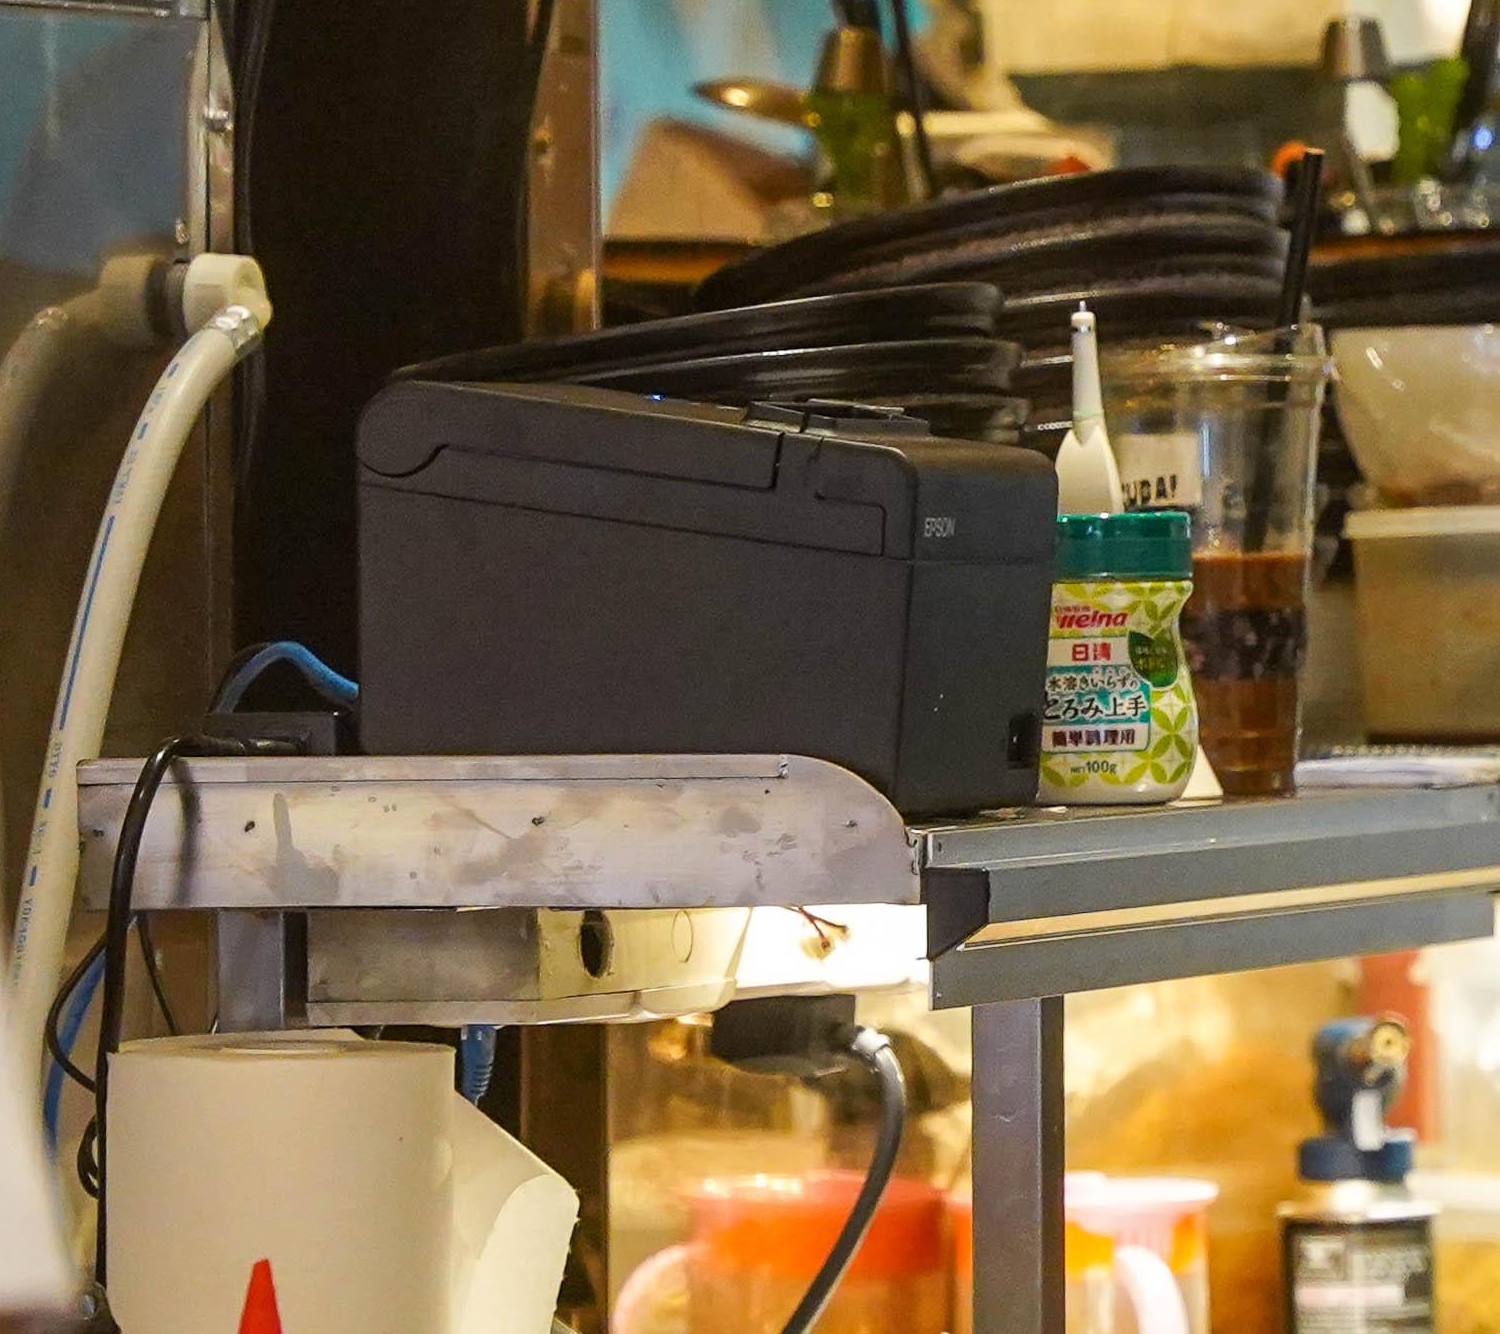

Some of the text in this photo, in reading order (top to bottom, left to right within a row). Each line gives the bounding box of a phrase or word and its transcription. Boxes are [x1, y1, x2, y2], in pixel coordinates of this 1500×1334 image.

[923, 517, 956, 537] EPSON
[1072, 642, 1111, 661] 日清
[1043, 695, 1146, 719] とろみ上手
[1086, 760, 1118, 775] 100g
